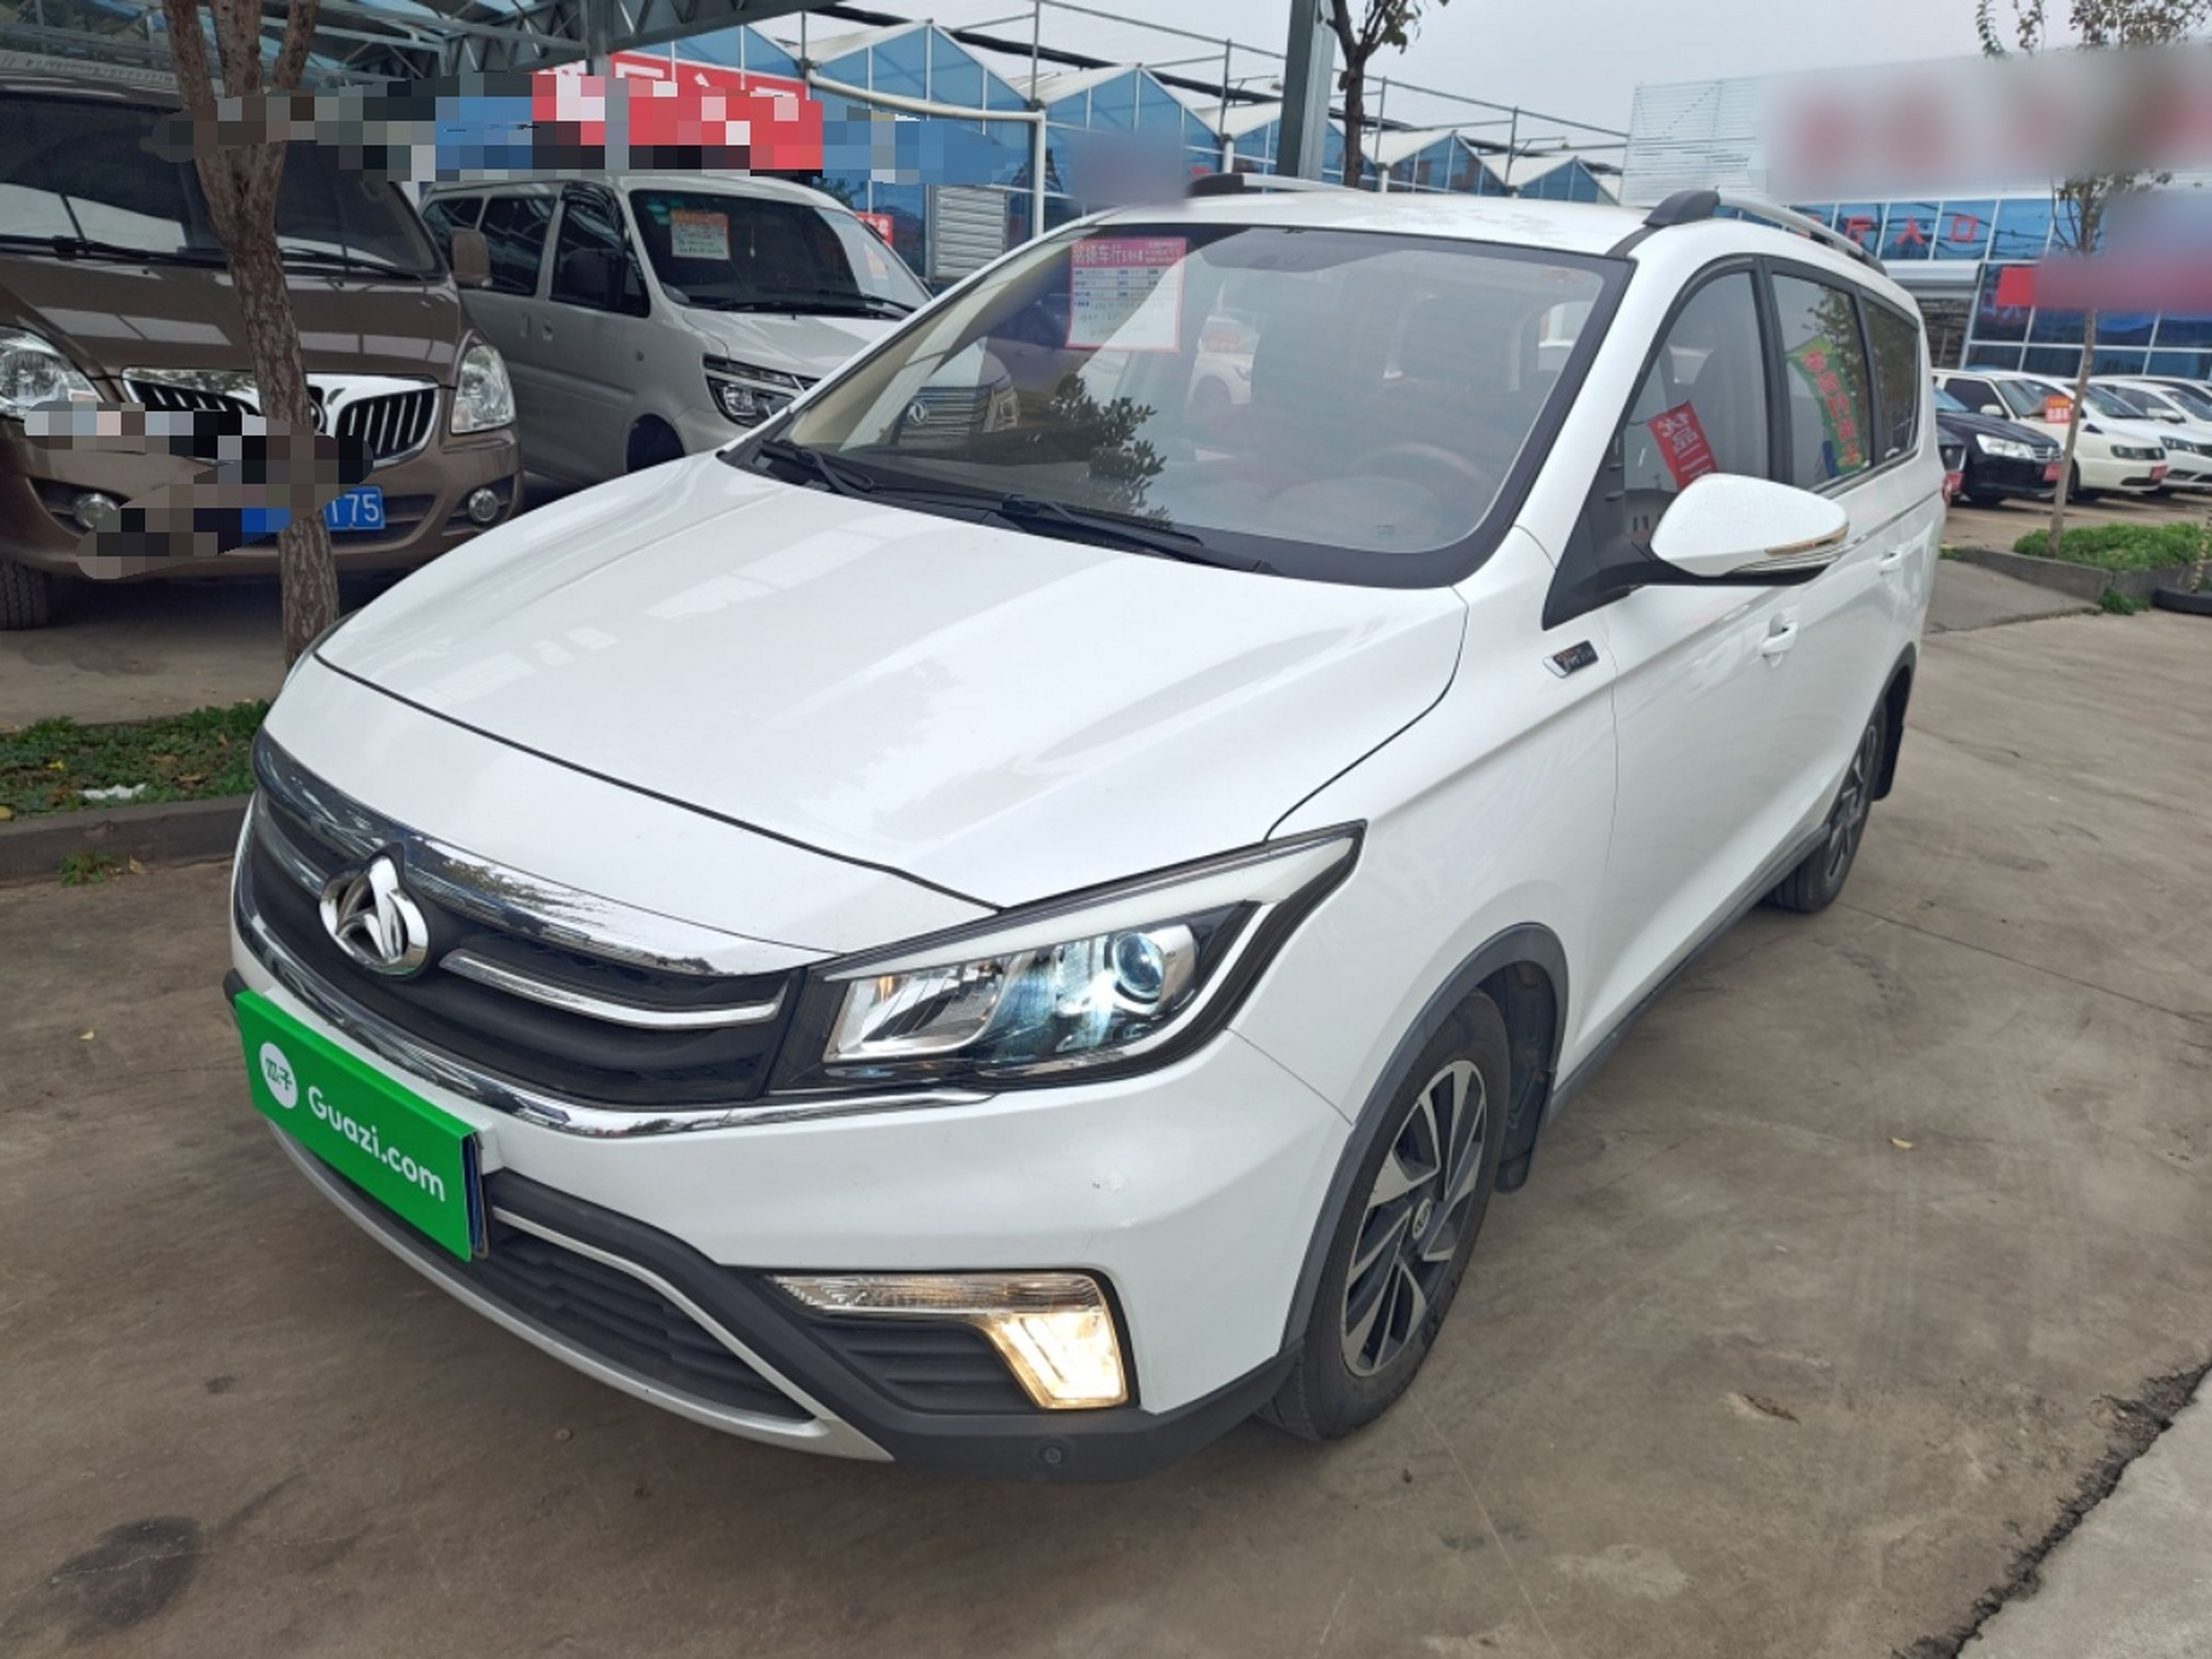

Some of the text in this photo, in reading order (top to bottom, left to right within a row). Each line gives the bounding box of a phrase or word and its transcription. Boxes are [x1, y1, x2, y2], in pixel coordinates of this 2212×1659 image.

[1797, 215, 1978, 245] 厅入口
[308, 1085, 446, 1202] Guazi.com
